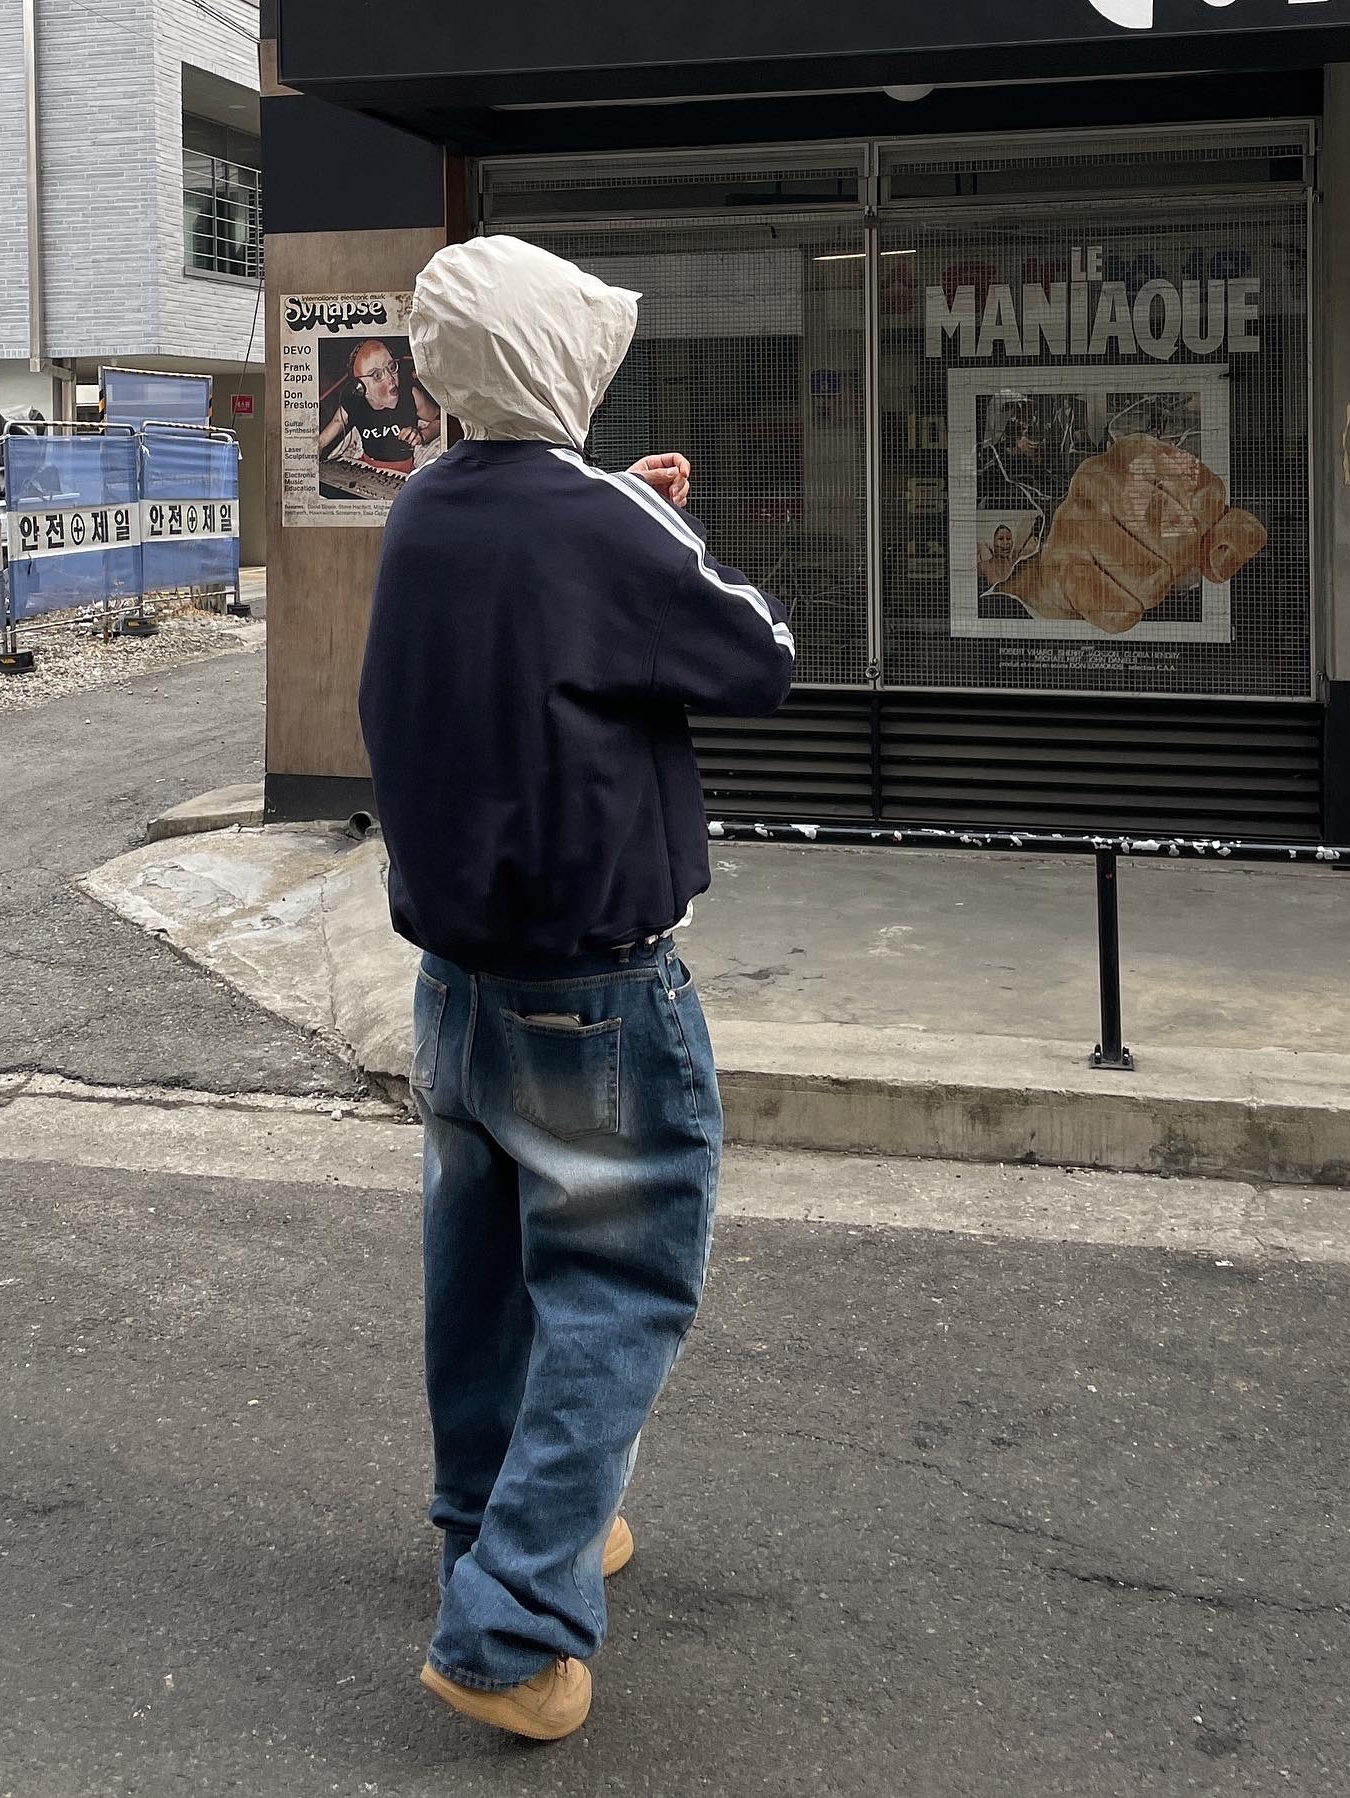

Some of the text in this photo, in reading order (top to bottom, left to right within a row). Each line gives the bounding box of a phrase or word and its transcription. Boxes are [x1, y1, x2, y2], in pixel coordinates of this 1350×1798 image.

[1071, 246, 1102, 281] LE
[284, 296, 387, 333] Synapse
[925, 278, 1260, 360] MANIAQUE
[283, 345, 312, 355] DEVO
[283, 362, 311, 372] Frank
[283, 372, 313, 384] Zappa
[284, 390, 303, 399] Don
[284, 400, 319, 409] Preston
[284, 427, 316, 435] Synthesis
[362, 424, 401, 439] DEVO
[284, 453, 318, 461] Sculptures
[284, 471, 316, 479] Electronic
[150, 504, 232, 536] 안전 제일
[20, 509, 130, 551] 안전 제일
